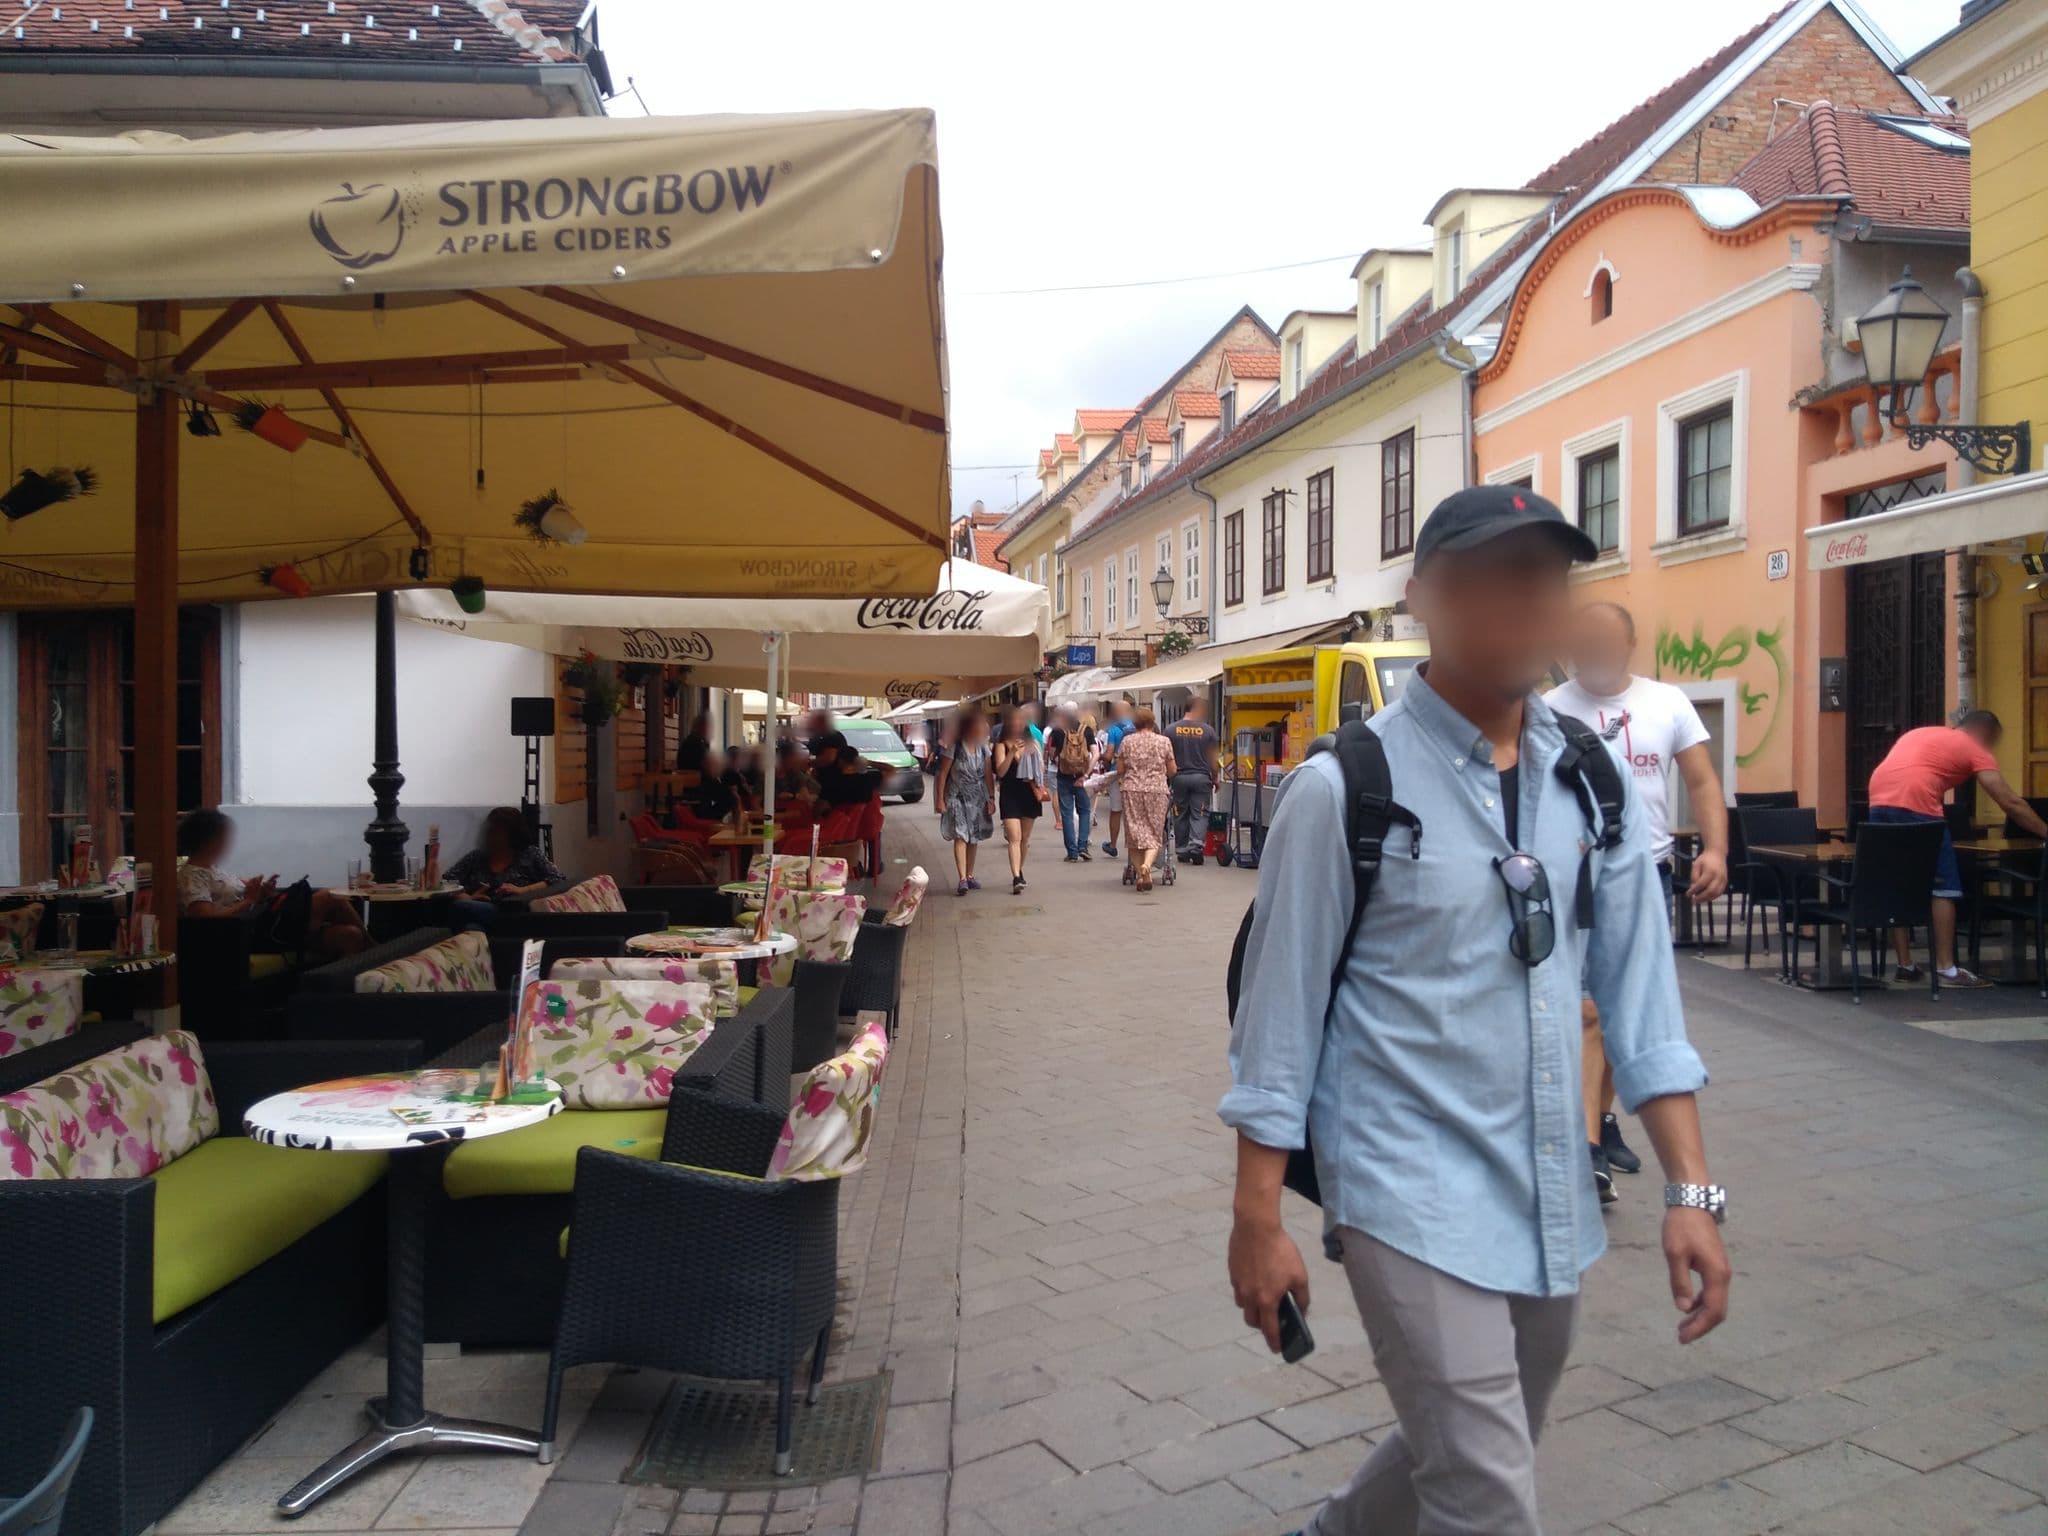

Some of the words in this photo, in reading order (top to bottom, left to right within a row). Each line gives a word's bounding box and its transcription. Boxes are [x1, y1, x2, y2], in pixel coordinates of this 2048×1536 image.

[438, 165, 775, 227] STRONGBOW
[437, 230, 538, 255] APPLE
[554, 226, 672, 251] CIDERS
[1175, 726, 1204, 736] ROTO
